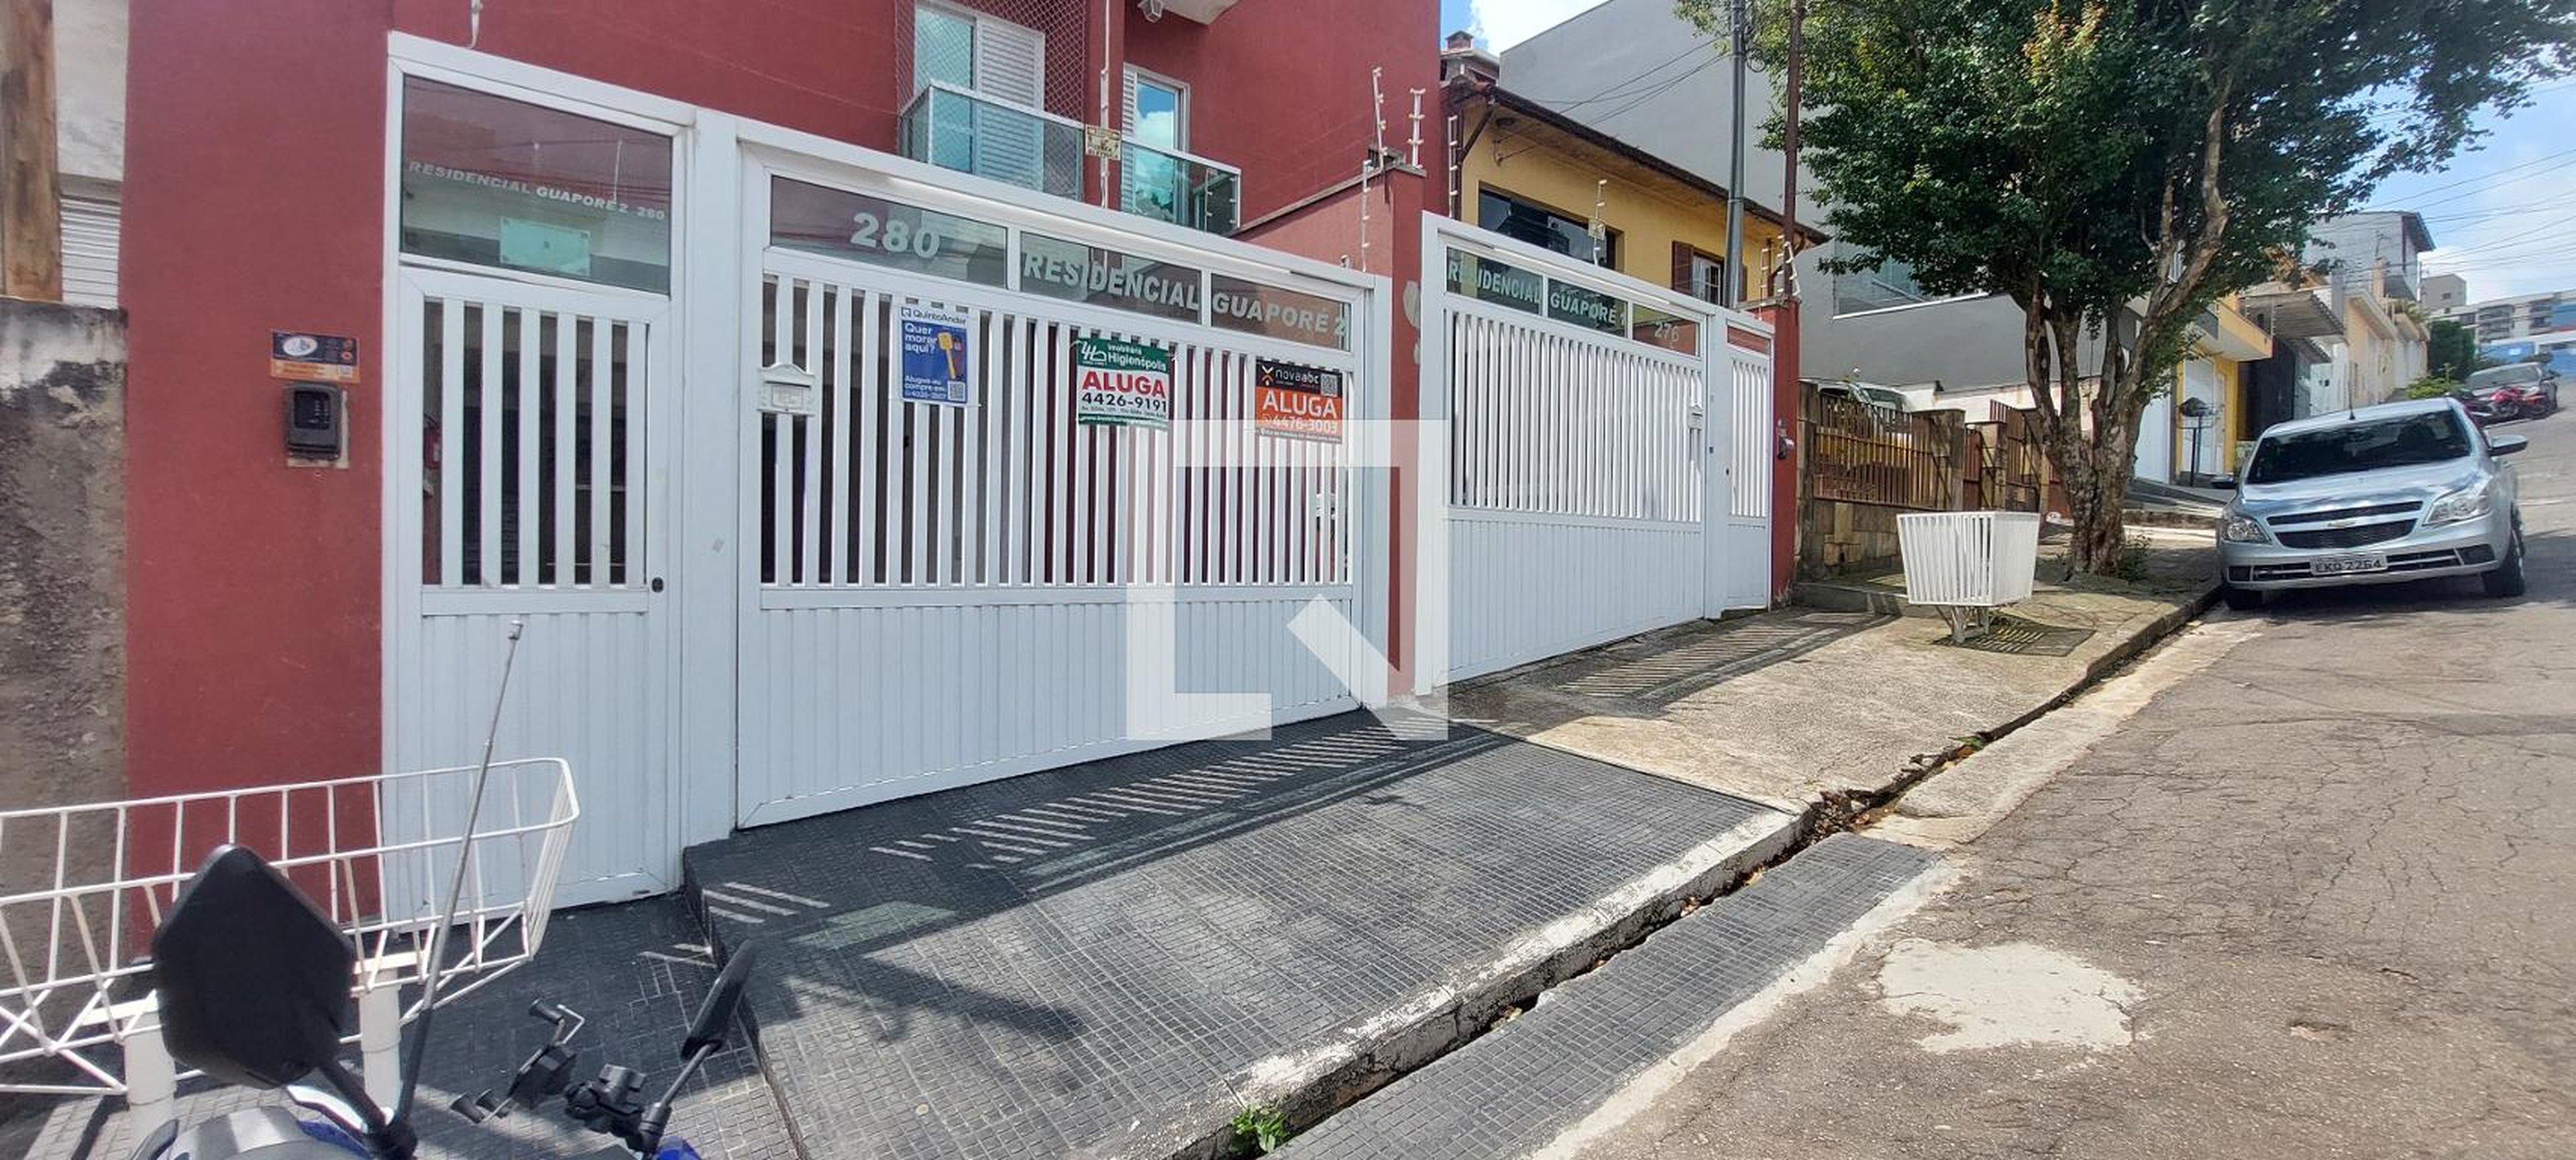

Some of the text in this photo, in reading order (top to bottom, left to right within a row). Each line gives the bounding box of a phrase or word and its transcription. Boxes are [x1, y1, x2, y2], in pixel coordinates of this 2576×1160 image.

[409, 162, 531, 195] RESIDENCIAL
[618, 203, 629, 213] 2
[637, 207, 665, 221] 280
[850, 213, 940, 259] 280
[1022, 252, 1348, 336] RESIDENCIAL GUAPORÉ 2
[905, 323, 932, 334] Quer
[912, 309, 967, 325] QuintoAndar
[905, 343, 935, 354] aqui?
[1108, 352, 1167, 372] Higienópolis
[1081, 370, 1166, 399] ALUGA
[1081, 392, 1167, 413] 4426-9191
[1262, 389, 1338, 419] ALUGA
